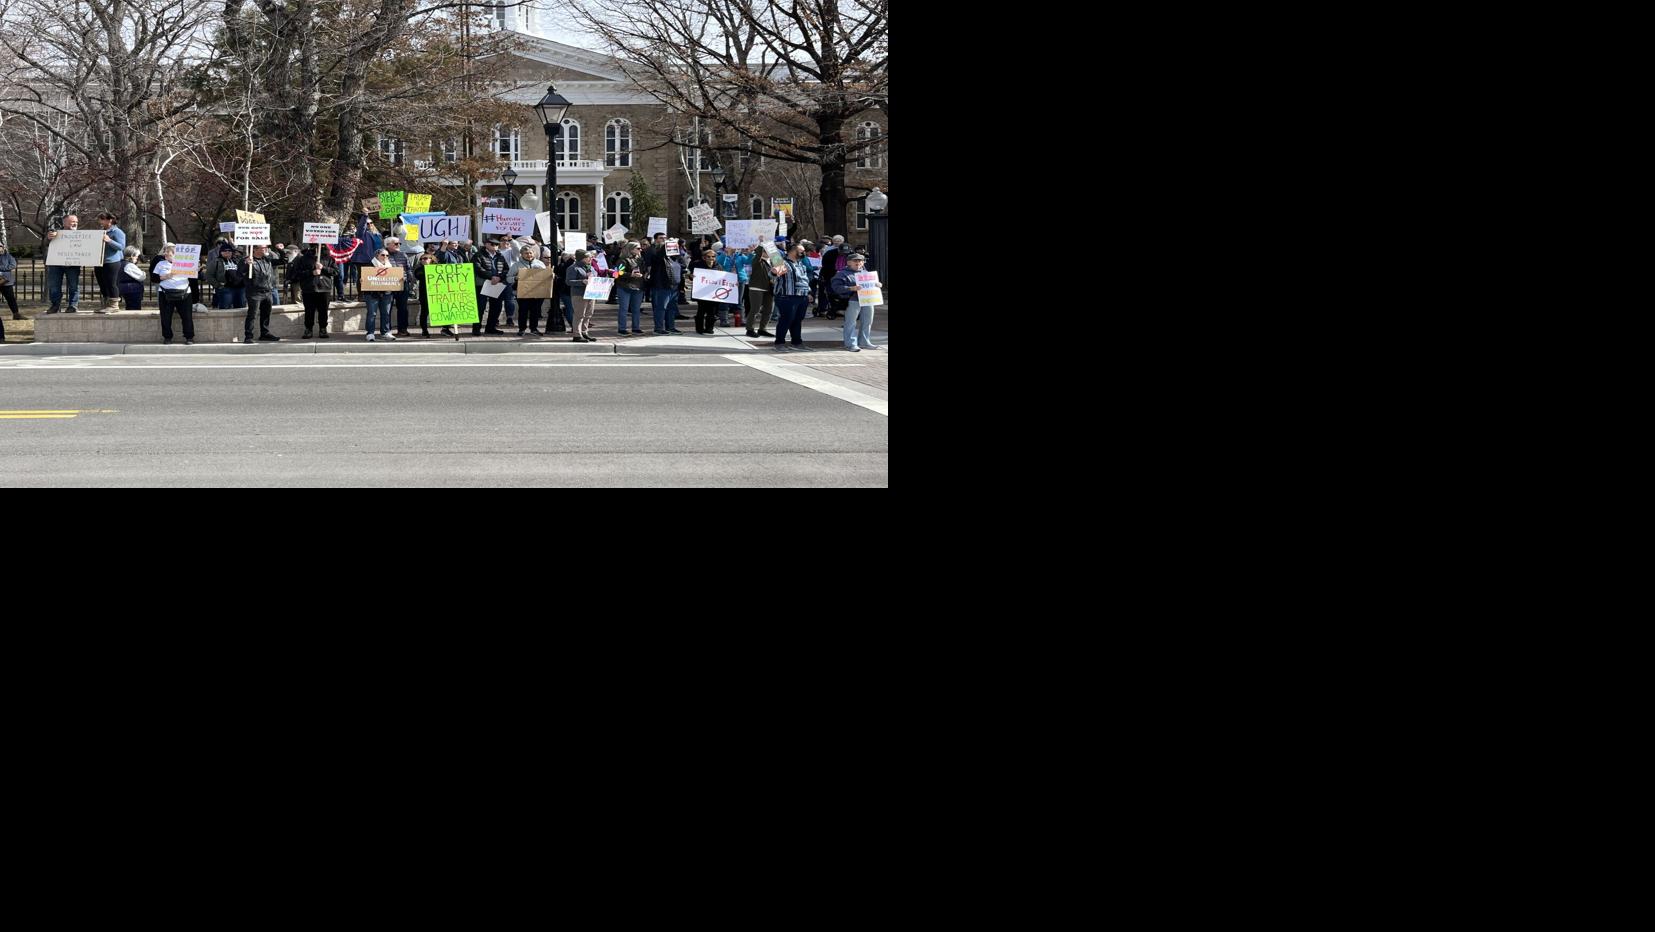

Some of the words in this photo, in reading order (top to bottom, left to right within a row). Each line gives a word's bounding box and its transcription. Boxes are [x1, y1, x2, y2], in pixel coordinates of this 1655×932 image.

[420, 217, 467, 239] UGH!
[435, 265, 463, 274] GOP
[427, 272, 469, 284] PARTY
[432, 283, 441, 293] T
[447, 282, 455, 293] L
[458, 282, 466, 292] C
[440, 301, 475, 313] LIARS
[431, 311, 477, 321] COWARDS
